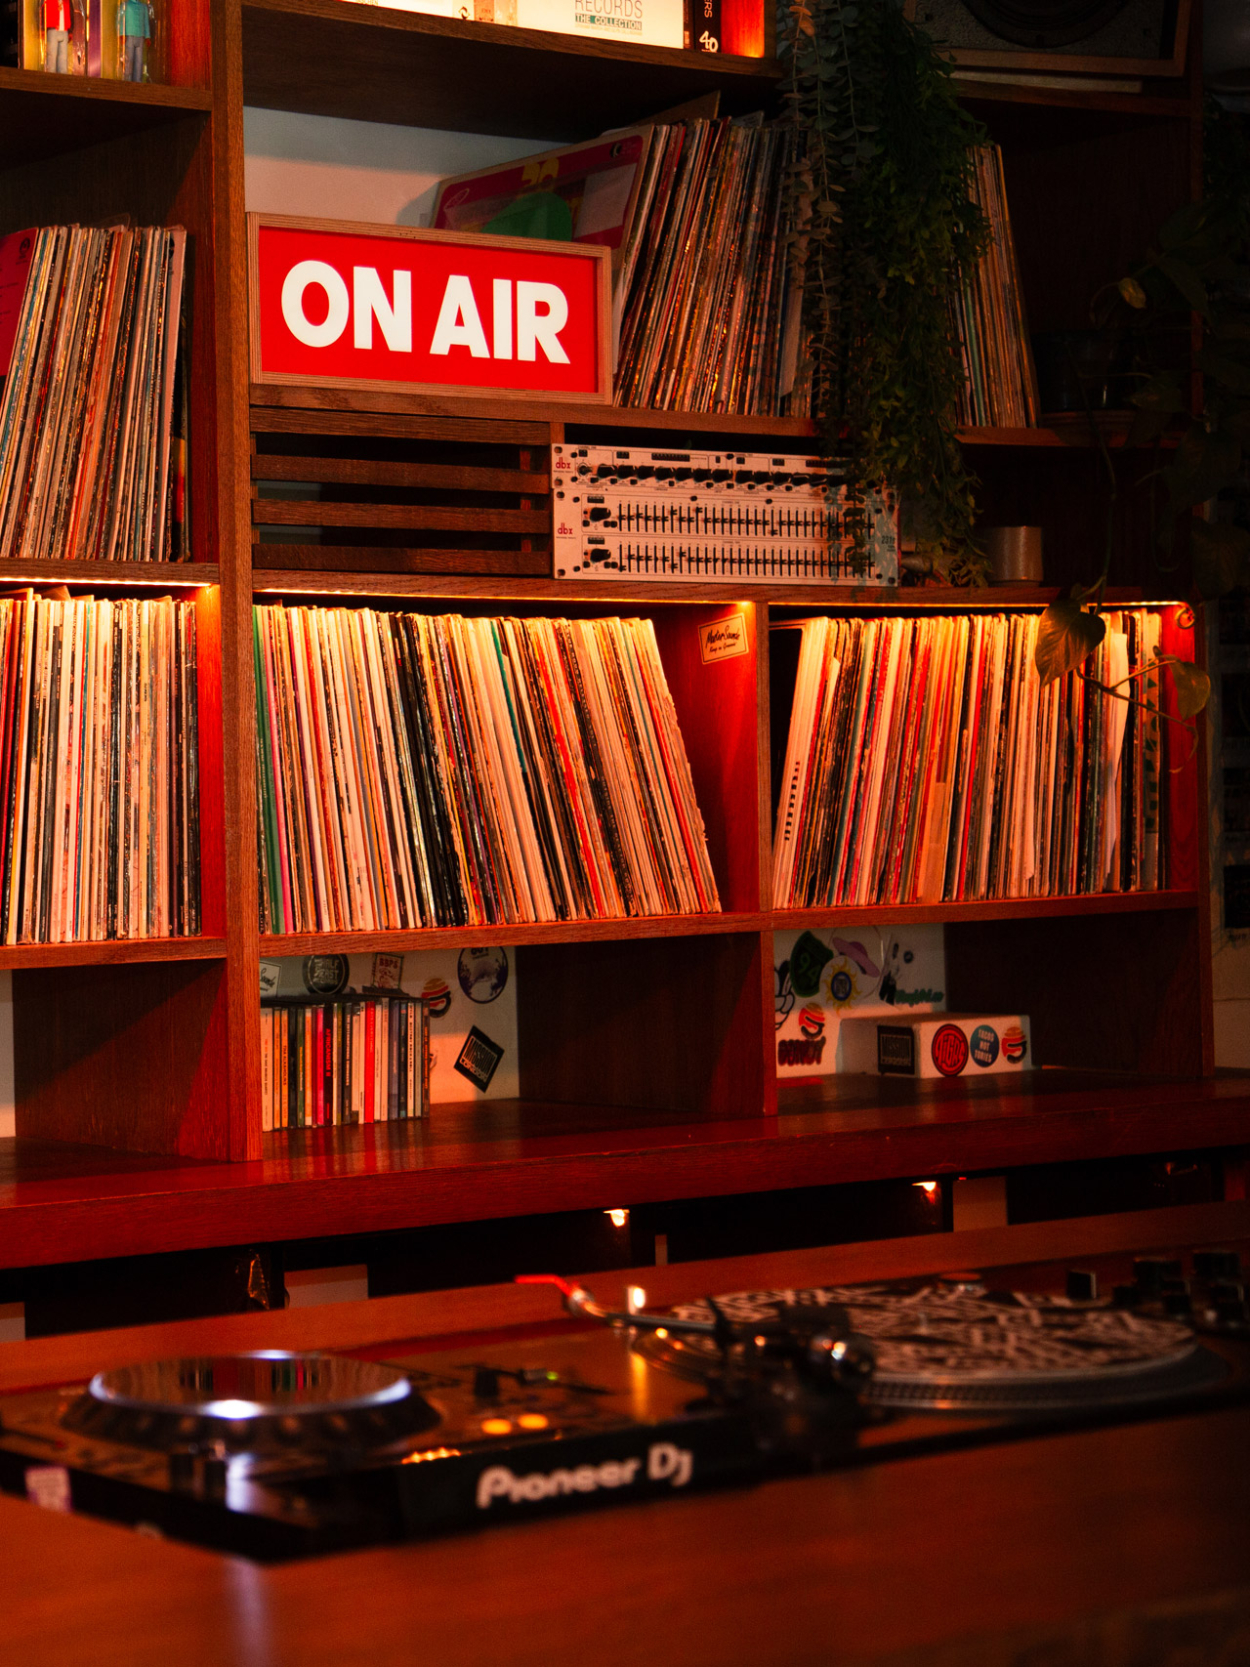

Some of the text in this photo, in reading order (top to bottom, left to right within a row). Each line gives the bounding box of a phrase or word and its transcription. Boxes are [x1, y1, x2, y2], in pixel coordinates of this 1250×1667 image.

[575, 0, 643, 19] RECORDS
[576, 14, 591, 24] THE
[595, 16, 641, 30] COLLECTION
[281, 259, 571, 364] ON AIR
[555, 457, 571, 469] dbx
[557, 522, 573, 535] dbx
[476, 1456, 642, 1510] Pioneer
